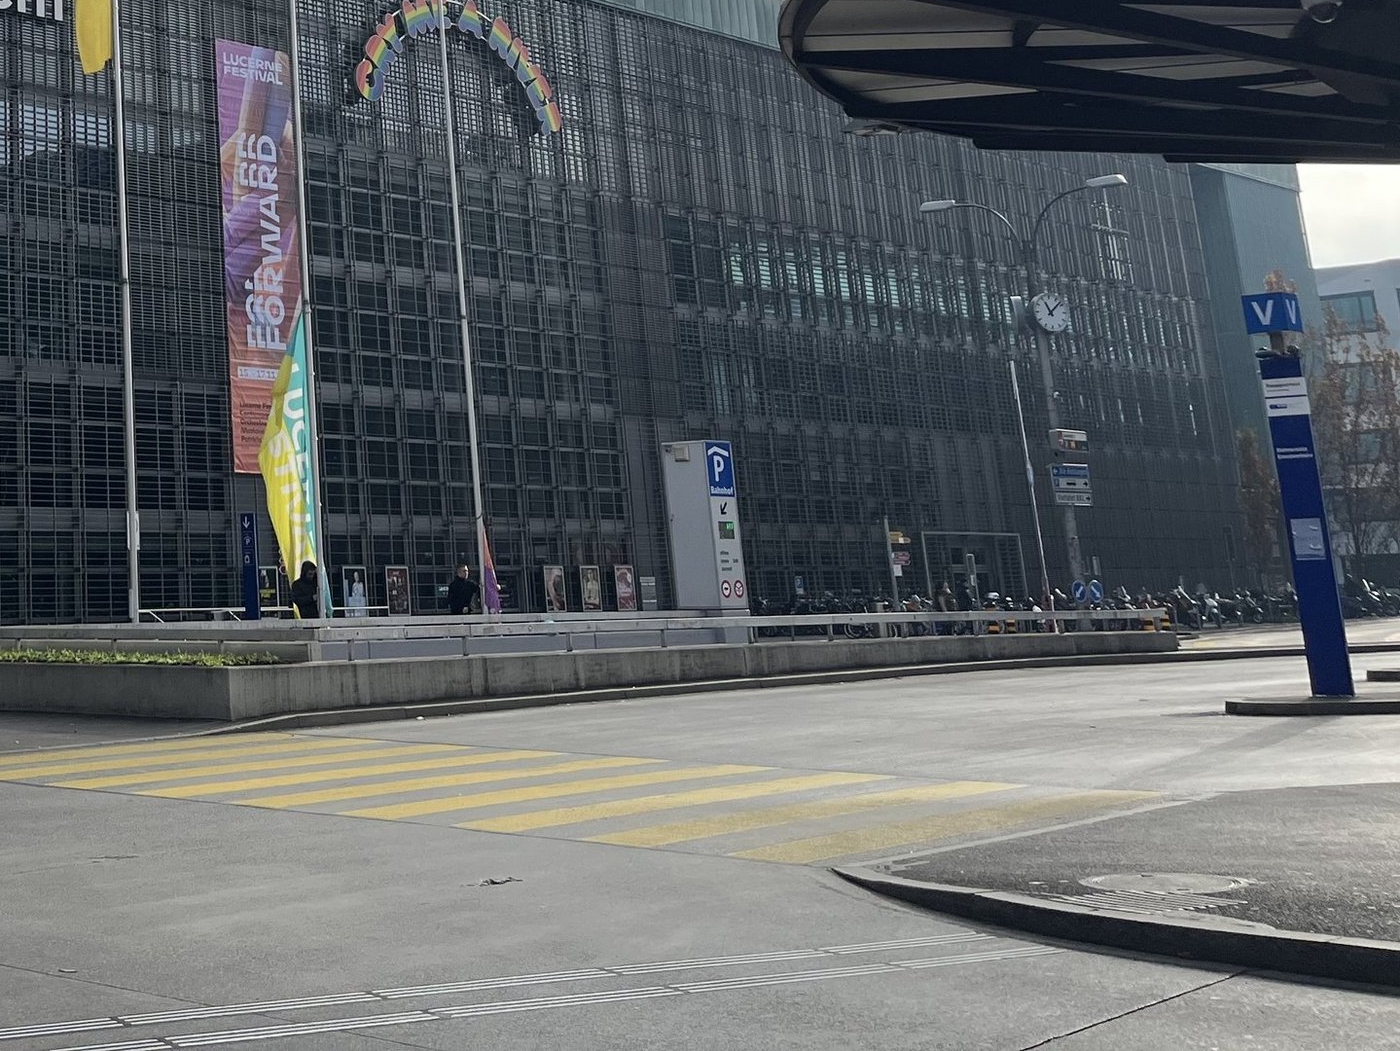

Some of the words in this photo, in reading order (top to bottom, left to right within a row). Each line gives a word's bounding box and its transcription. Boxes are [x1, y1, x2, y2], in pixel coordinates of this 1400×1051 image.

[223, 52, 283, 73] LUCERNE
[224, 66, 284, 85] FESTIVAL
[257, 135, 287, 350] FORWARD
[1251, 299, 1274, 325] V
[1285, 299, 1296, 325] V
[713, 456, 724, 482] P
